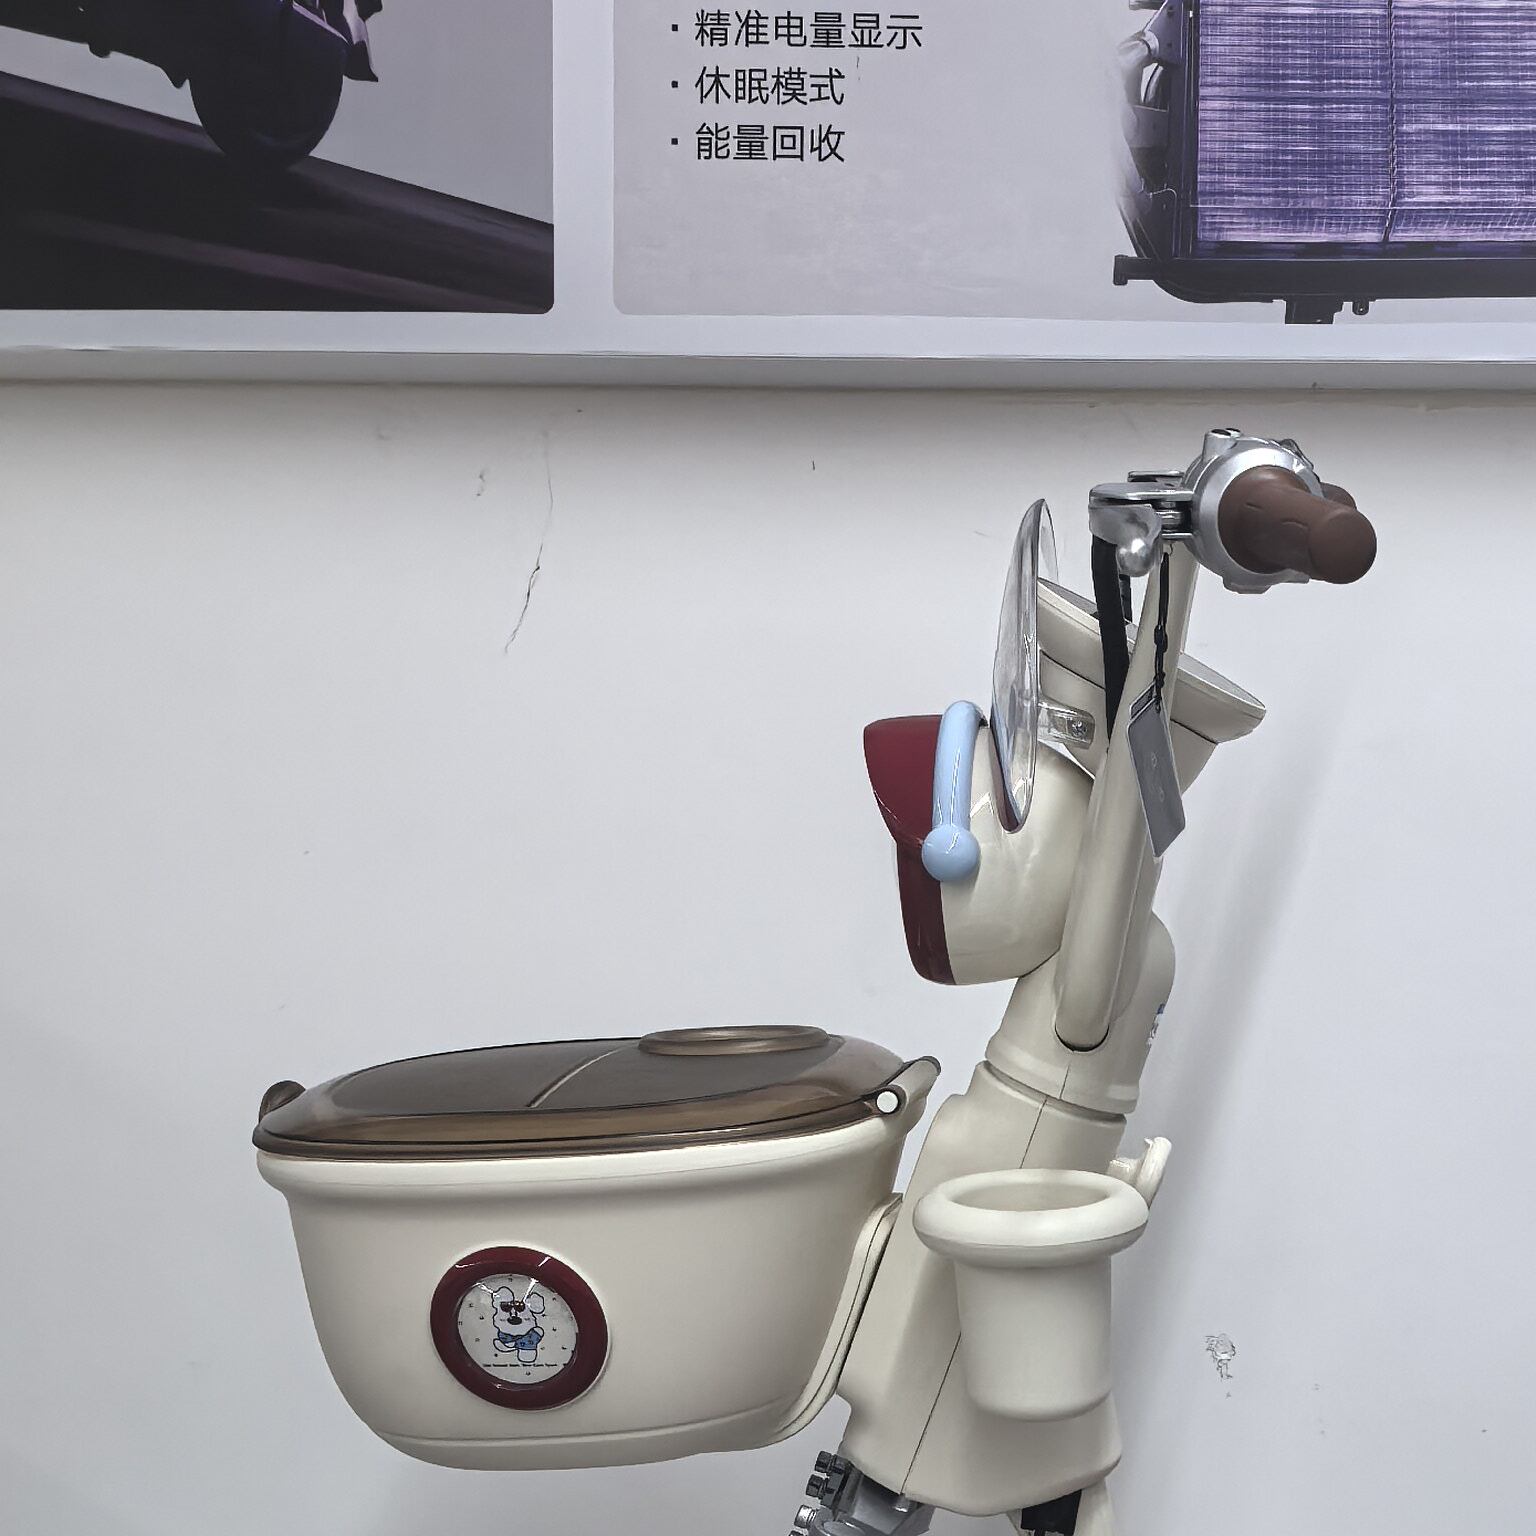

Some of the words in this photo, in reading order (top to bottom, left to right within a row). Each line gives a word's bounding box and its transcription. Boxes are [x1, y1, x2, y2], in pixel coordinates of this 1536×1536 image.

[694, 9, 922, 49] 精准电量显示
[694, 66, 845, 105] 休眠模式
[694, 122, 845, 162] 能量回收
